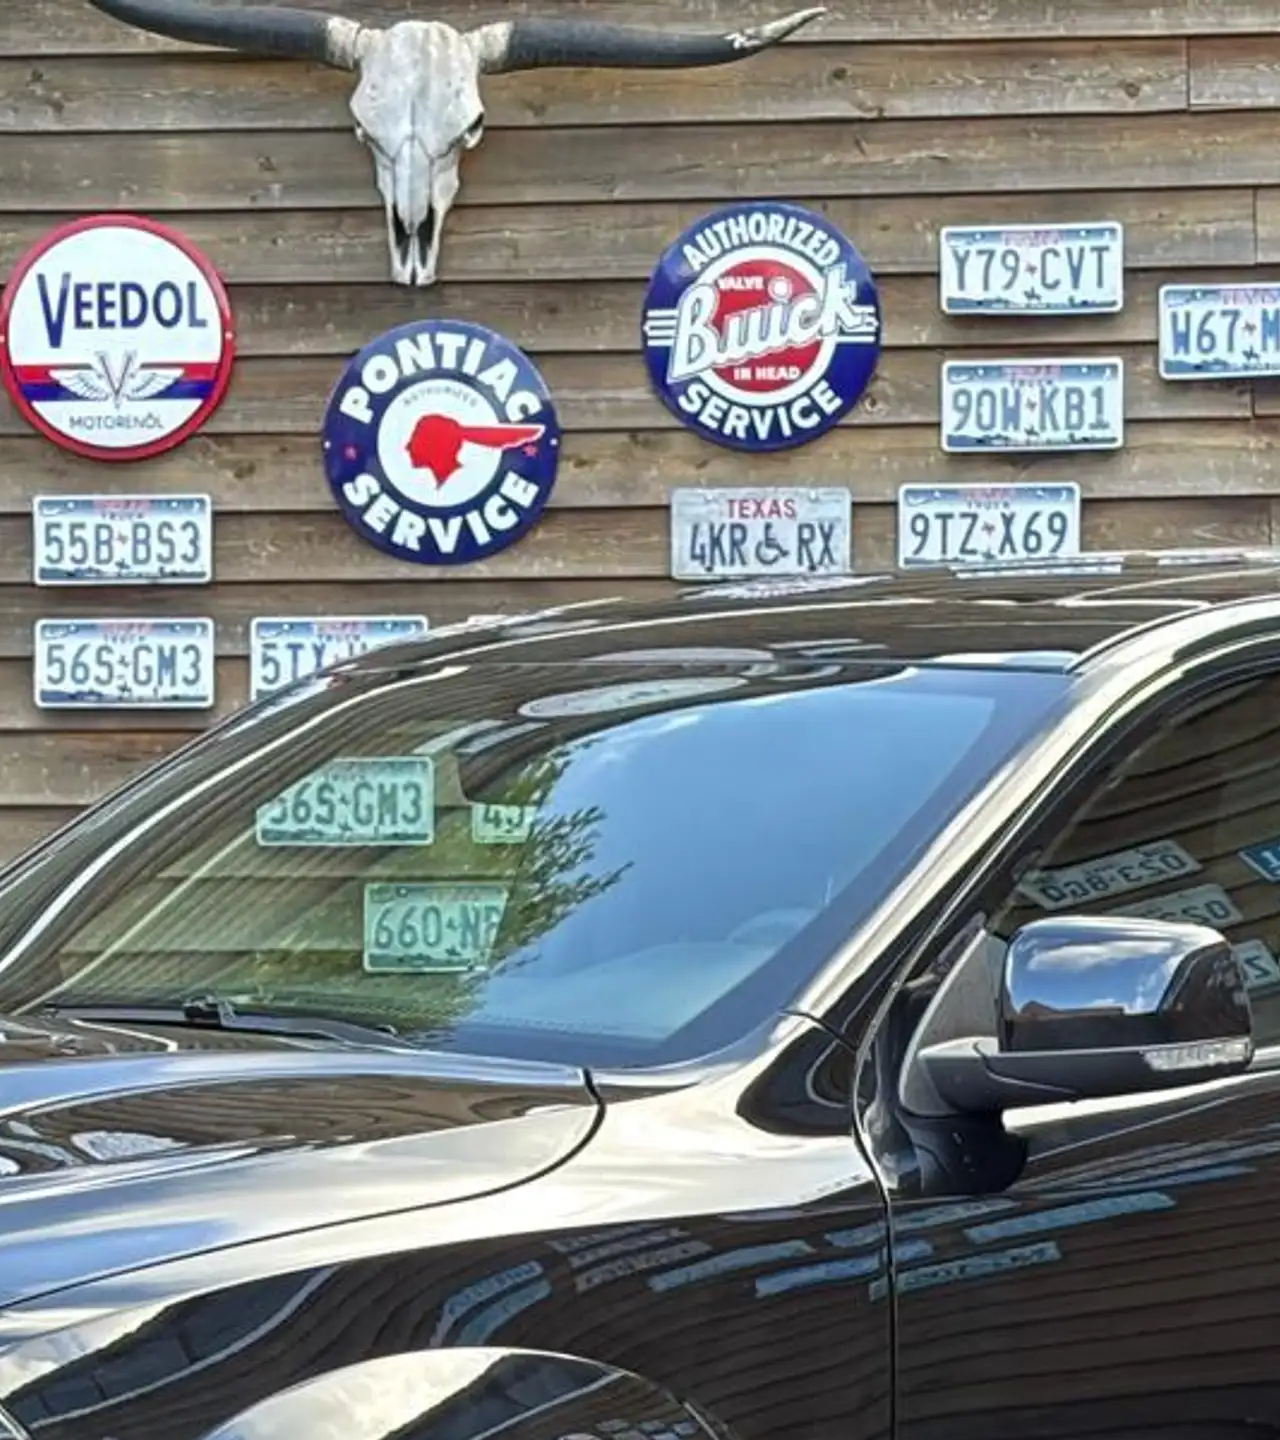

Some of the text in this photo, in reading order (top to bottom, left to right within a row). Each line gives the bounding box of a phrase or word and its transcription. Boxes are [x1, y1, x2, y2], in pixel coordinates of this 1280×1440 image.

[683, 212, 841, 271] AUTHORIZED
[36, 272, 208, 348] VEEDOL
[667, 263, 862, 384] Buick
[340, 332, 543, 424] PONTIAC
[678, 380, 843, 440] SERVICE
[342, 470, 540, 553] SERVICE
[727, 498, 797, 520] TEXAS
